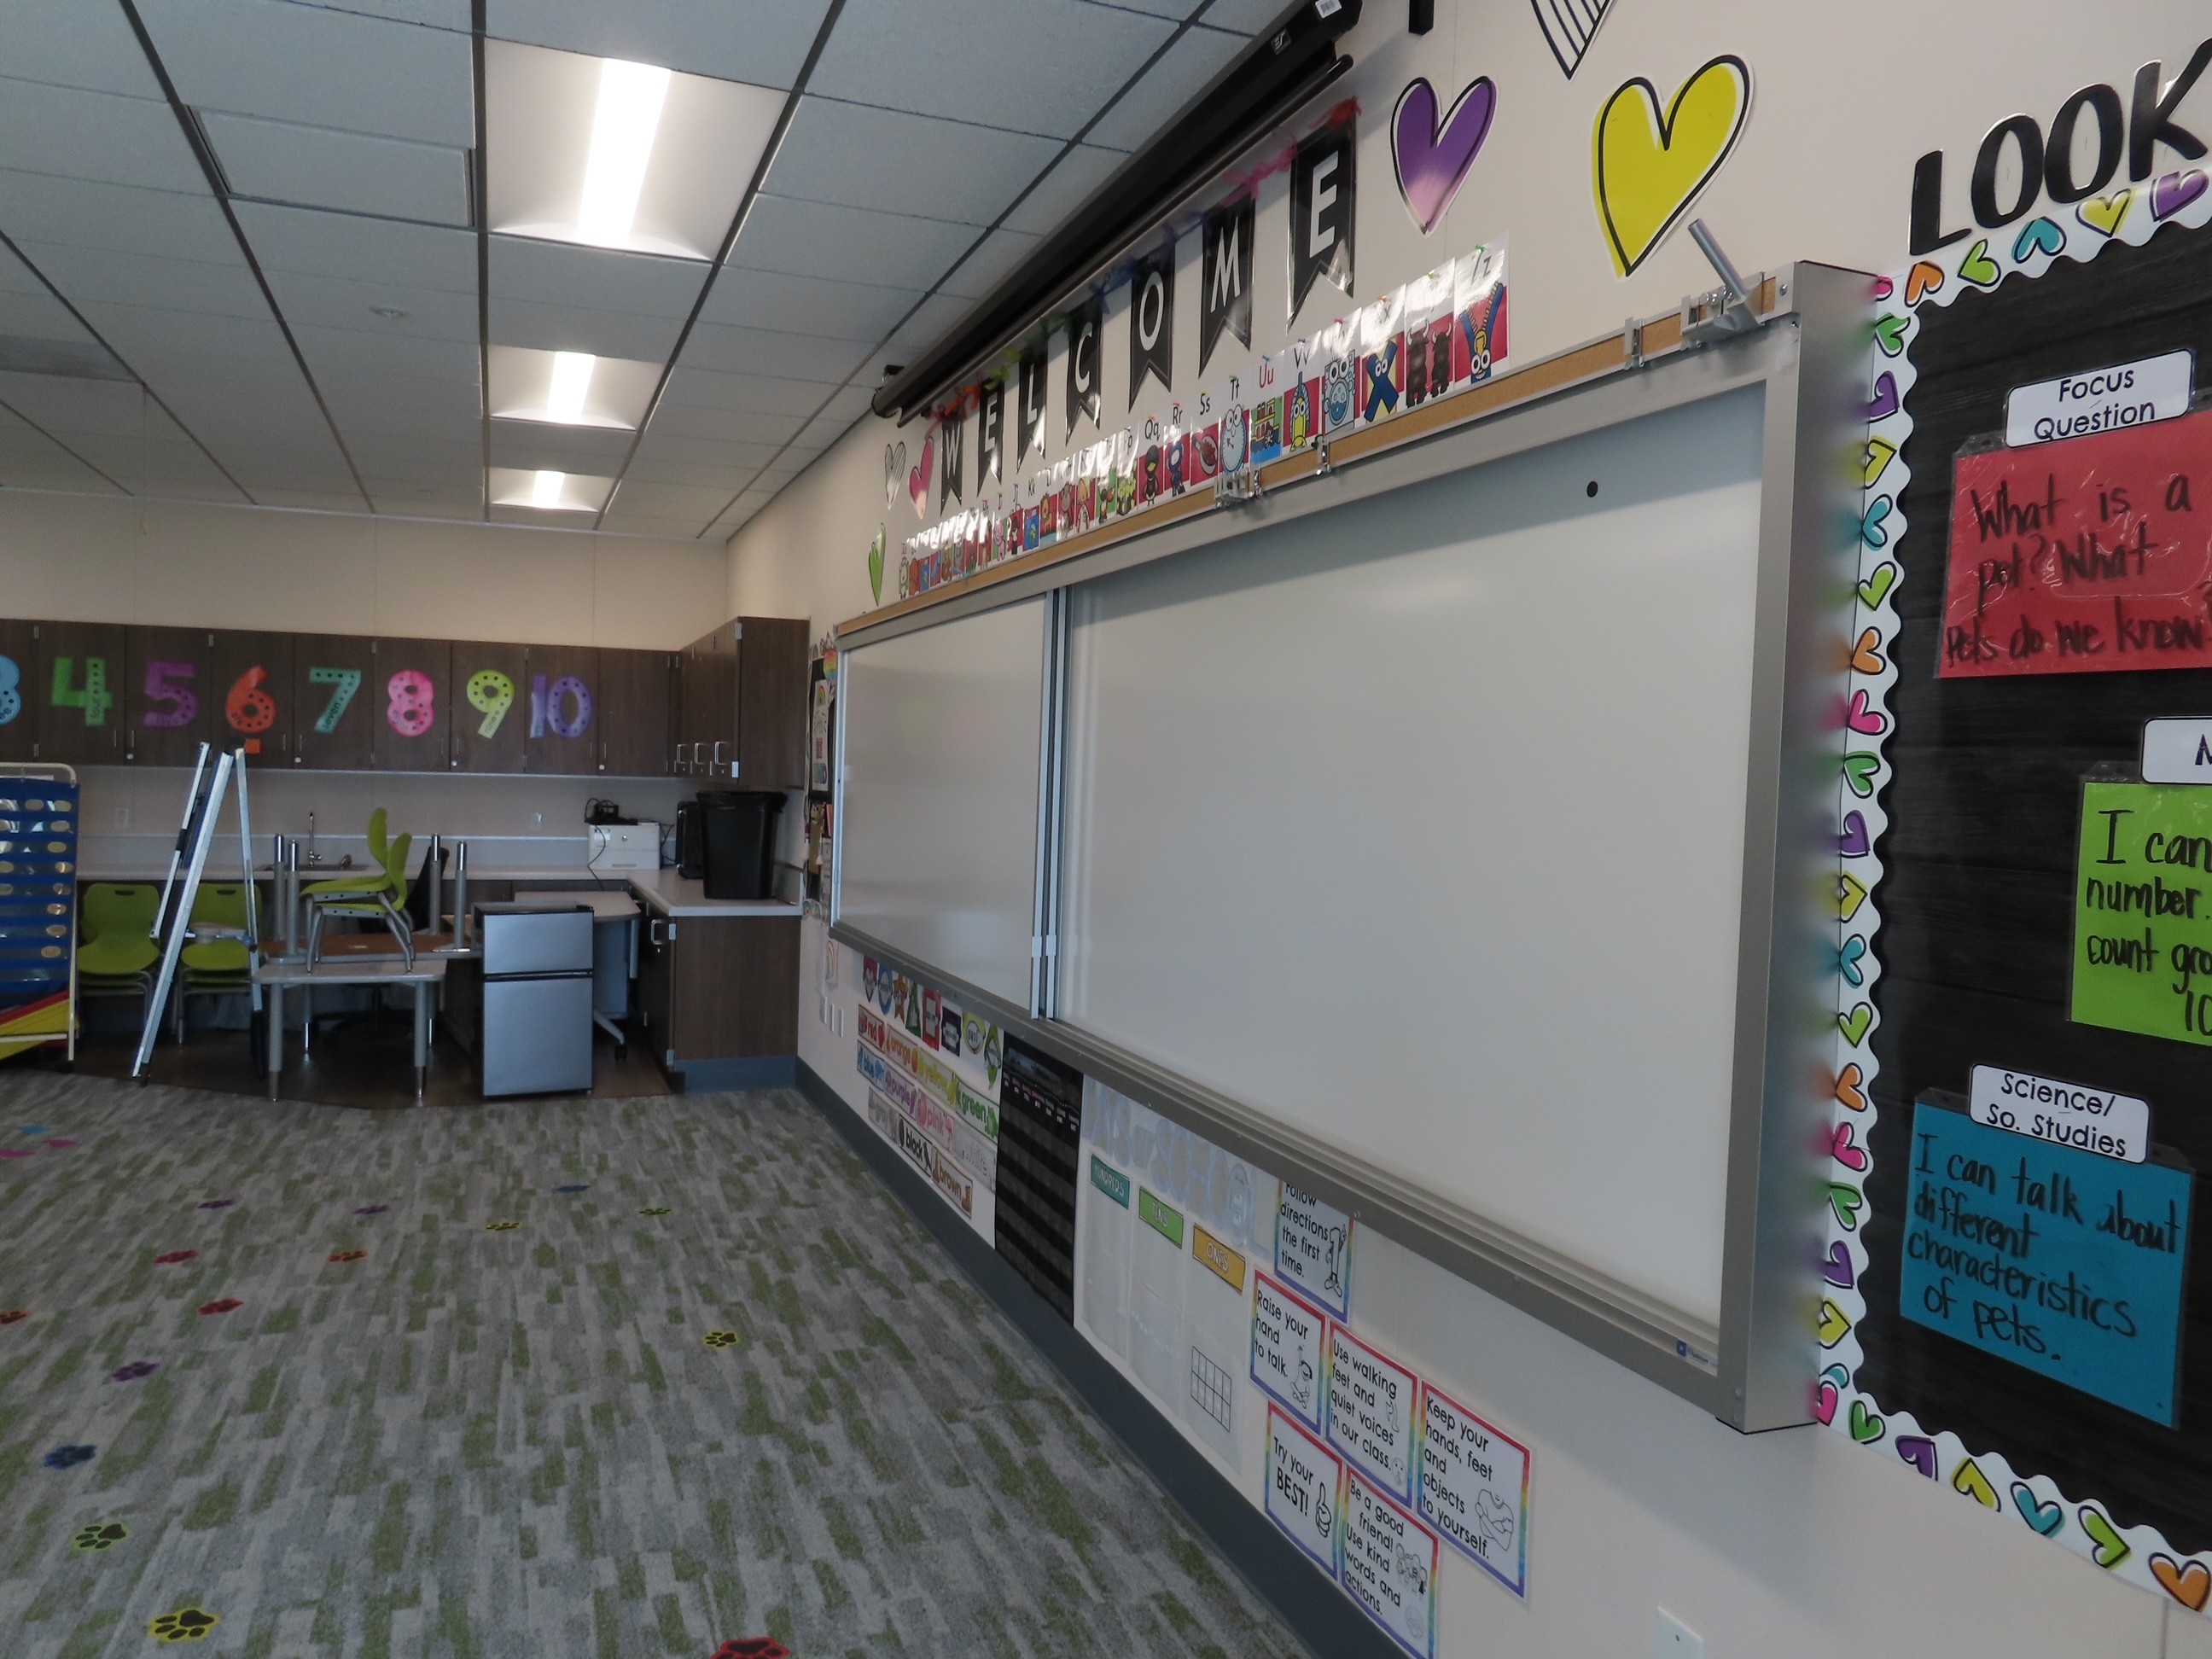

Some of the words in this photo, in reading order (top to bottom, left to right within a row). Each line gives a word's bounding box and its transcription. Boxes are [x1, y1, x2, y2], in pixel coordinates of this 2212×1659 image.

[1909, 38, 2212, 255] LOOK
[944, 152, 1340, 480] WELCOME
[1144, 419, 1160, 441] Qq
[1173, 405, 1183, 425] Rr
[1200, 393, 1211, 416] Ss
[1230, 378, 1240, 401] Tt
[1260, 363, 1274, 388] Uu
[2058, 368, 2135, 403] Focus
[2033, 400, 2157, 443] Question
[1970, 473, 2066, 543] What
[2096, 483, 2131, 522] is
[2164, 474, 2192, 512] a
[2054, 521, 2159, 584] What
[2010, 614, 2044, 660] do
[2056, 620, 2105, 657] we
[50, 656, 113, 726] 4
[143, 661, 200, 728] 5
[225, 663, 278, 733] 6
[310, 667, 362, 734] 7
[387, 669, 435, 736] 8
[467, 669, 515, 739] 9
[530, 673, 594, 739] 10
[2096, 809, 2135, 864] I
[2145, 832, 2212, 873] can
[2086, 876, 2211, 920] number.
[2087, 927, 2160, 973] count
[961, 1092, 987, 1124] green
[2000, 1073, 2116, 1117] Science/
[1986, 1103, 2021, 1132] So.
[2030, 1114, 2127, 1158] Studies
[905, 1126, 923, 1162] black
[940, 1168, 962, 1202] brown
[1094, 1163, 1125, 1197] HUNDREDS
[1152, 1202, 1168, 1227] TENS
[1207, 1242, 1229, 1272] ONES
[1913, 1179, 2040, 1259] different
[1915, 1132, 1939, 1175] I
[1947, 1153, 1995, 1195] can
[2011, 1156, 2085, 1226] talk
[2095, 1189, 2182, 1254] about
[1280, 1202, 1329, 1242] directions
[1282, 1225, 1298, 1249] the
[1301, 1235, 1320, 1262] first
[1281, 1249, 1306, 1278] time.
[1907, 1231, 2138, 1338] characteristics
[1256, 1289, 1282, 1320] Raise
[1284, 1313, 1308, 1340] your
[1923, 1276, 1959, 1319] of
[1254, 1315, 1280, 1345] hand
[1254, 1337, 1265, 1358] to
[1267, 1349, 1289, 1379] talk.
[1333, 1340, 1349, 1365] Use
[1352, 1355, 1397, 1400] walking
[1331, 1362, 1350, 1390] feet
[1353, 1381, 1376, 1408] and
[1330, 1388, 1355, 1419] quiet
[1359, 1410, 1394, 1447] voices
[1330, 1411, 1339, 1430] in
[1342, 1424, 1359, 1446] our
[1362, 1435, 1392, 1472] class.
[1427, 1395, 1456, 1431] Keep
[1460, 1423, 1489, 1452] your
[1273, 1436, 1288, 1464] Try
[1289, 1457, 1314, 1486] your
[1423, 1448, 1447, 1475] and
[1425, 1420, 1463, 1464] hands,
[1467, 1452, 1493, 1482] feet
[1276, 1467, 1309, 1517] BEST!
[1350, 1477, 1362, 1501] Be
[1363, 1497, 1372, 1511] a
[1375, 1502, 1405, 1537] good
[1423, 1471, 1466, 1515] objects
[1346, 1522, 1364, 1548] Use
[1366, 1545, 1391, 1574] kind
[1359, 1511, 1394, 1553] friend!
[1422, 1493, 1434, 1518] to
[1436, 1508, 1491, 1559] yourself.
[1344, 1548, 1377, 1585] words
[1379, 1580, 1401, 1608] and
[1345, 1571, 1384, 1615] actions.
